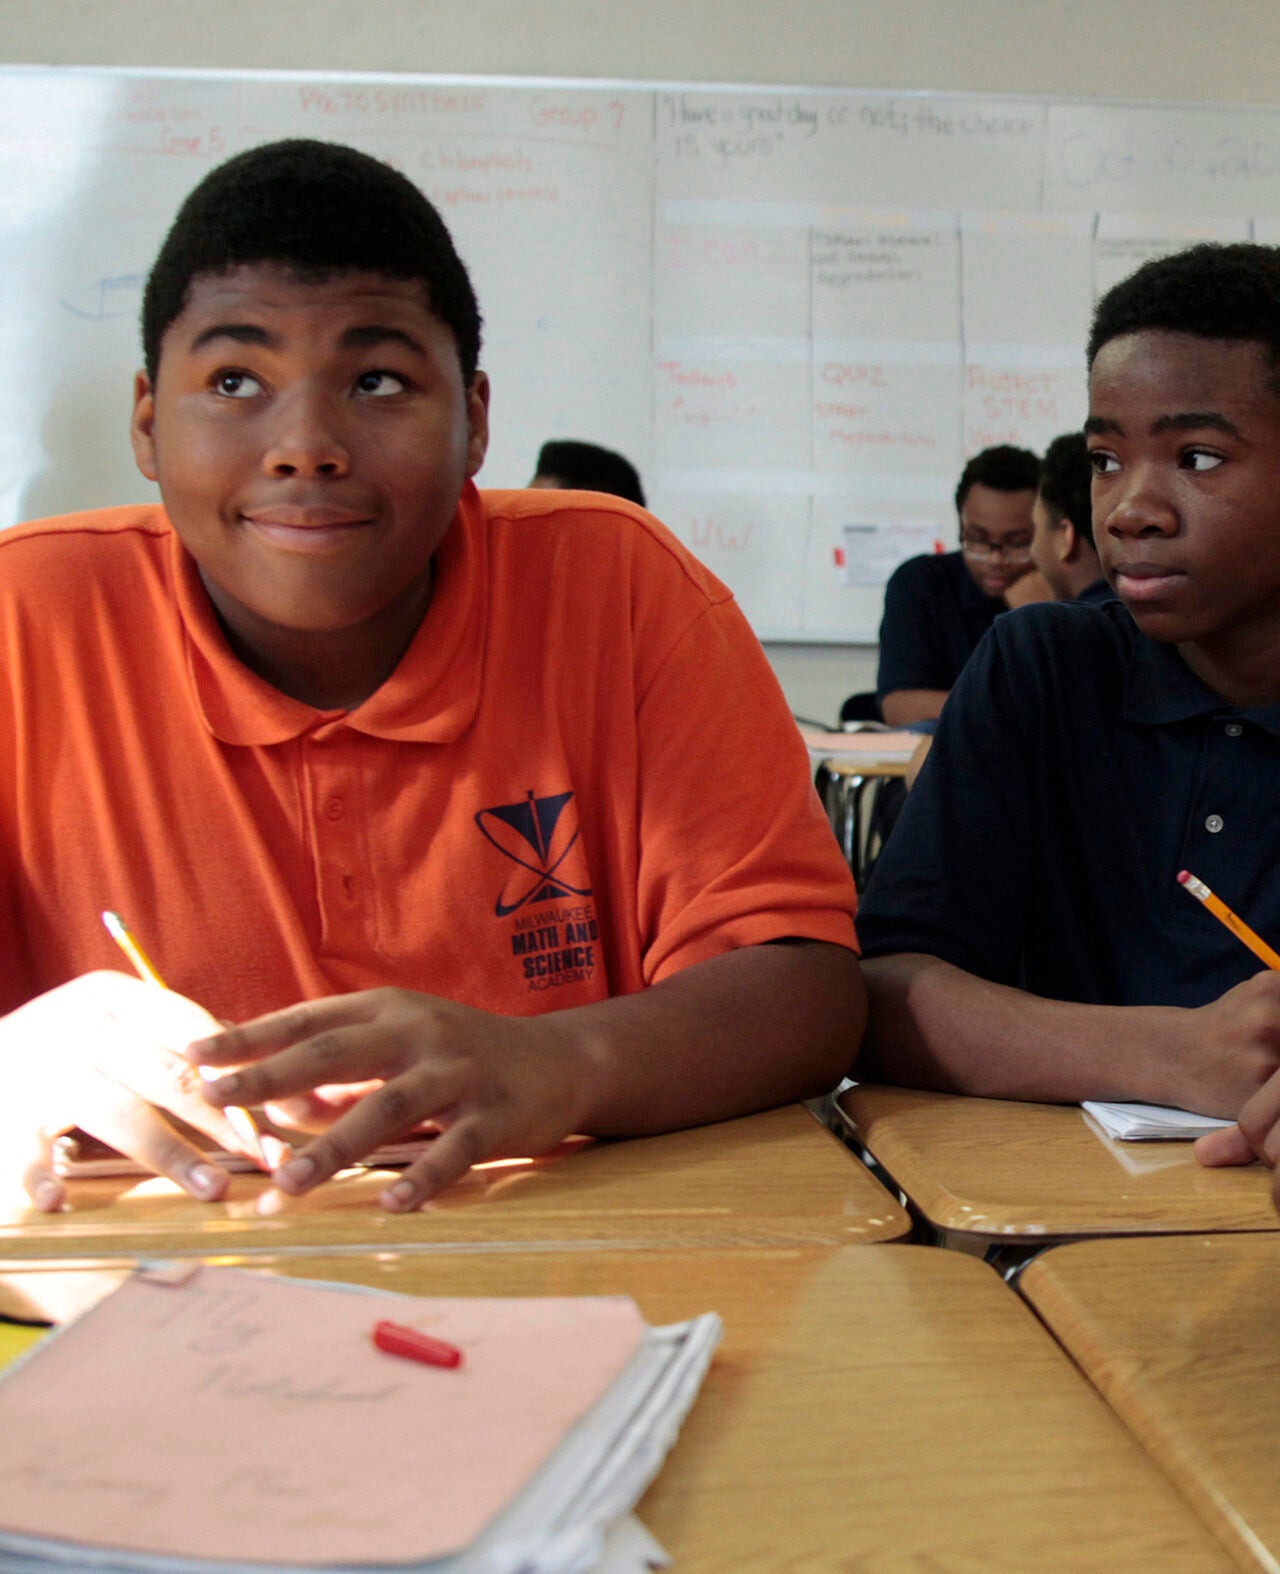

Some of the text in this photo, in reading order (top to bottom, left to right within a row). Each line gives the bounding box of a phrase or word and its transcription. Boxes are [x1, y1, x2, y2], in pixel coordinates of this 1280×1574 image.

[514, 905, 593, 931] MILWAUKEE
[511, 919, 599, 956] MATH AND
[522, 946, 595, 979] SCIENCE
[528, 969, 593, 992] ACADEMY
